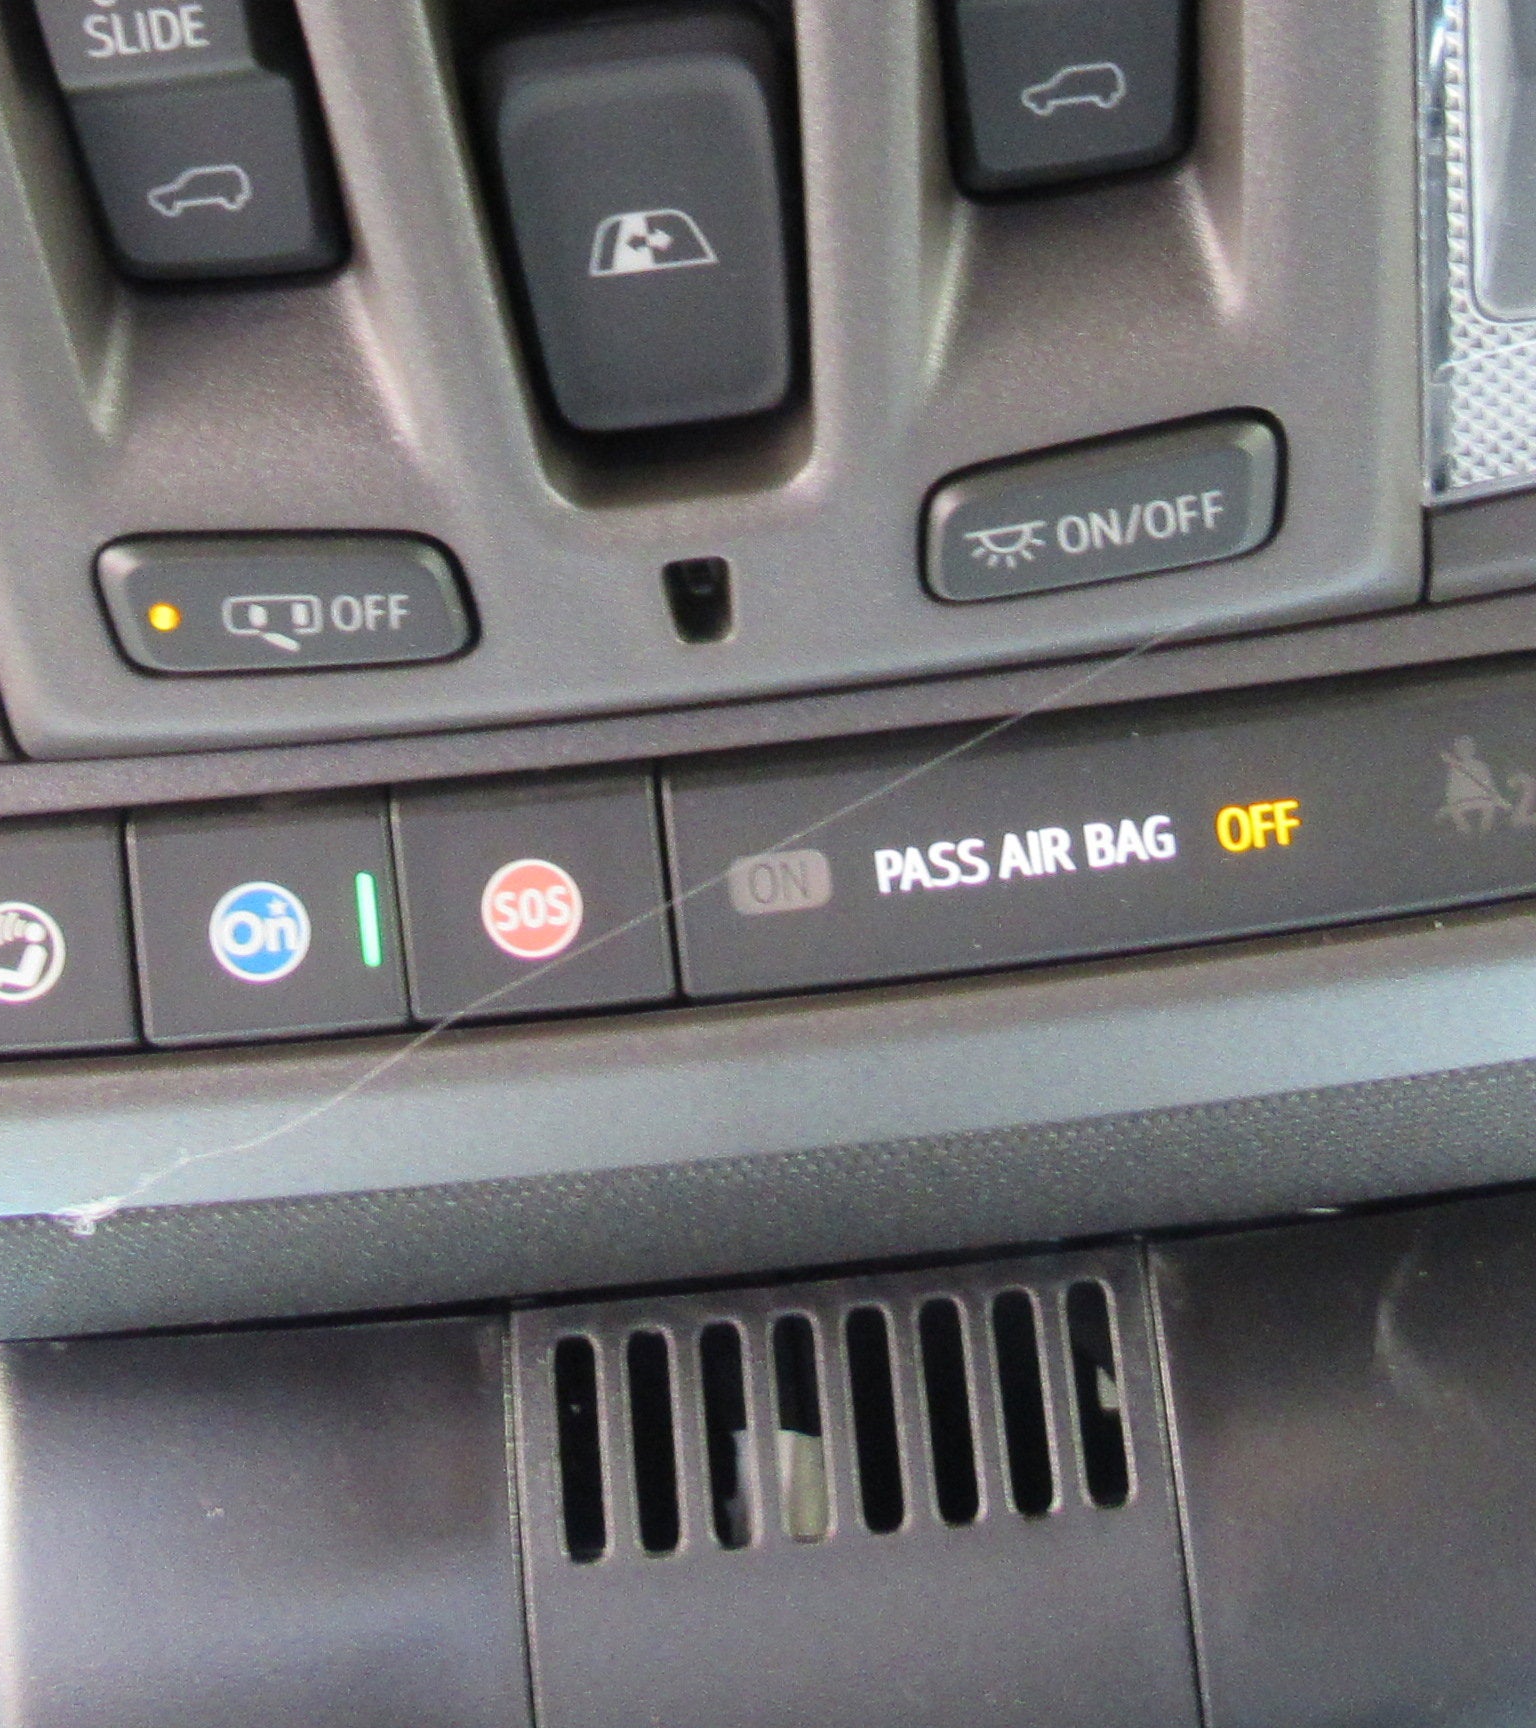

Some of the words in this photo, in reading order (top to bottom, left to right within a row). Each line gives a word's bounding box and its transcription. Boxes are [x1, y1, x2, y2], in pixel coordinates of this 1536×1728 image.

[82, 3, 210, 58] SLIDE
[1055, 489, 1226, 555] ON/OFF
[330, 593, 410, 632] OFF
[874, 837, 991, 894] PASS
[998, 827, 1078, 879] AIR
[1082, 814, 1178, 869] BAG
[1215, 798, 1302, 854] OFF
[748, 858, 809, 904] ON
[493, 884, 572, 932] SOS
